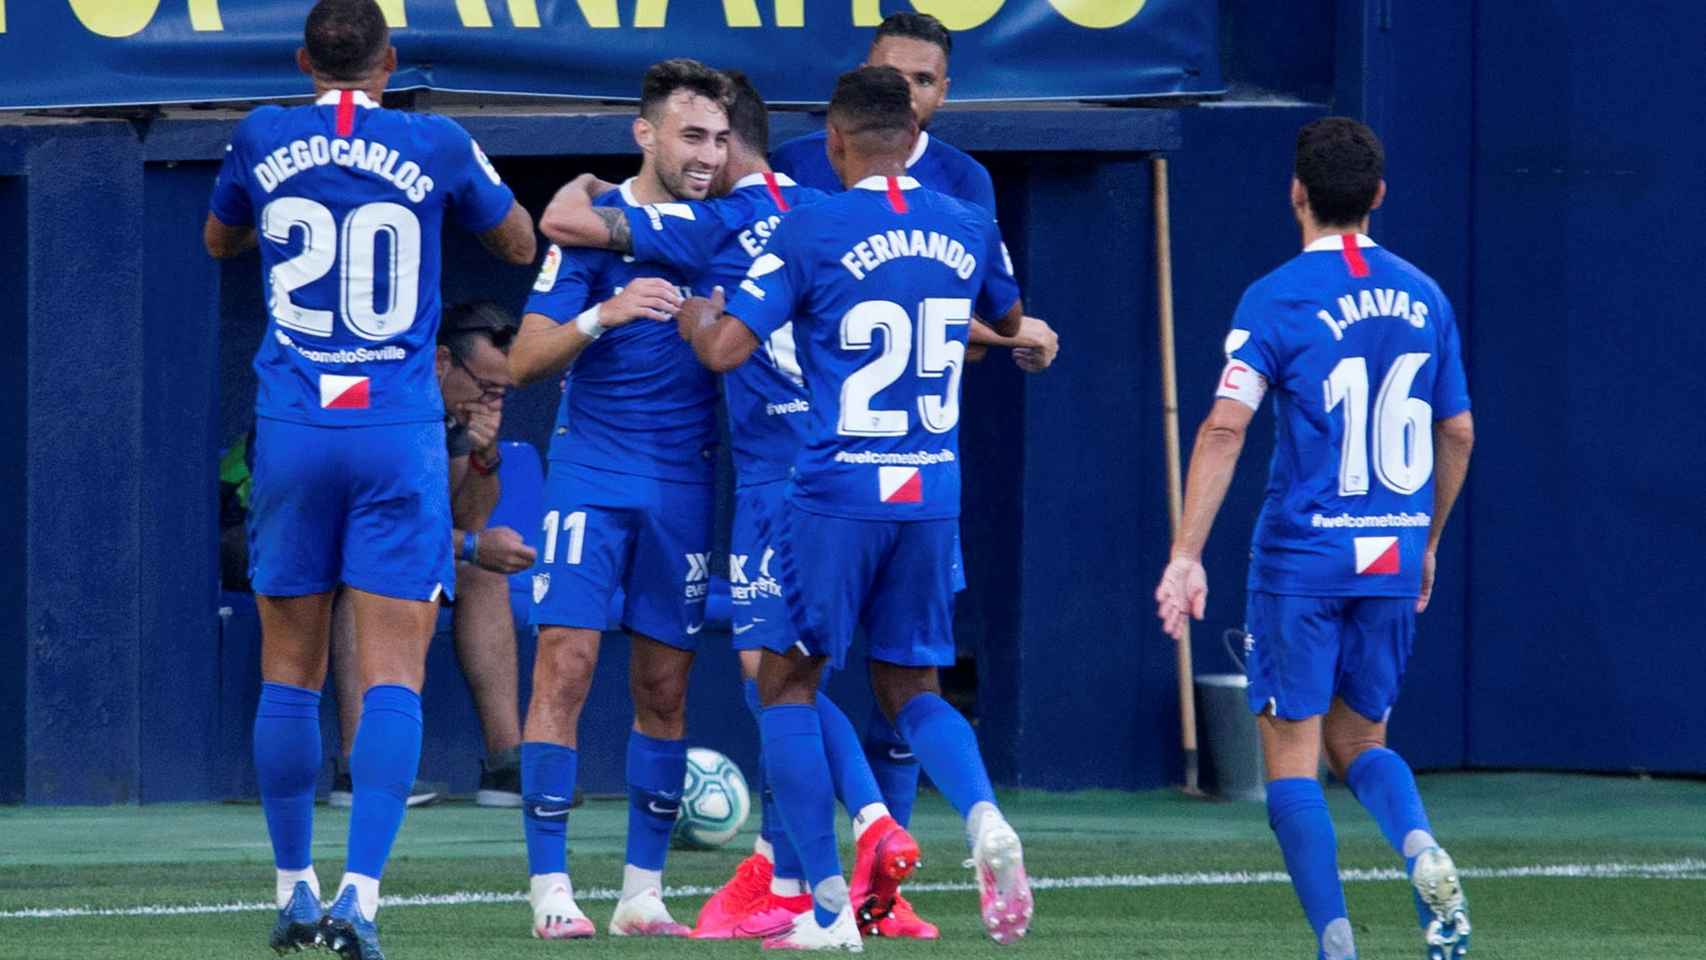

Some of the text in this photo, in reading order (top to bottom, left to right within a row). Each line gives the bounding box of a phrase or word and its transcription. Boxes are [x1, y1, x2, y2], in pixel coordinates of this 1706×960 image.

[253, 135, 434, 203] DIEGOCARLOS
[262, 196, 421, 341] 20
[840, 229, 977, 280] FERNANDO
[1316, 288, 1429, 341] J.NAVAS
[837, 298, 972, 437] 25
[1323, 353, 1434, 497] 16
[543, 510, 586, 565] 11
